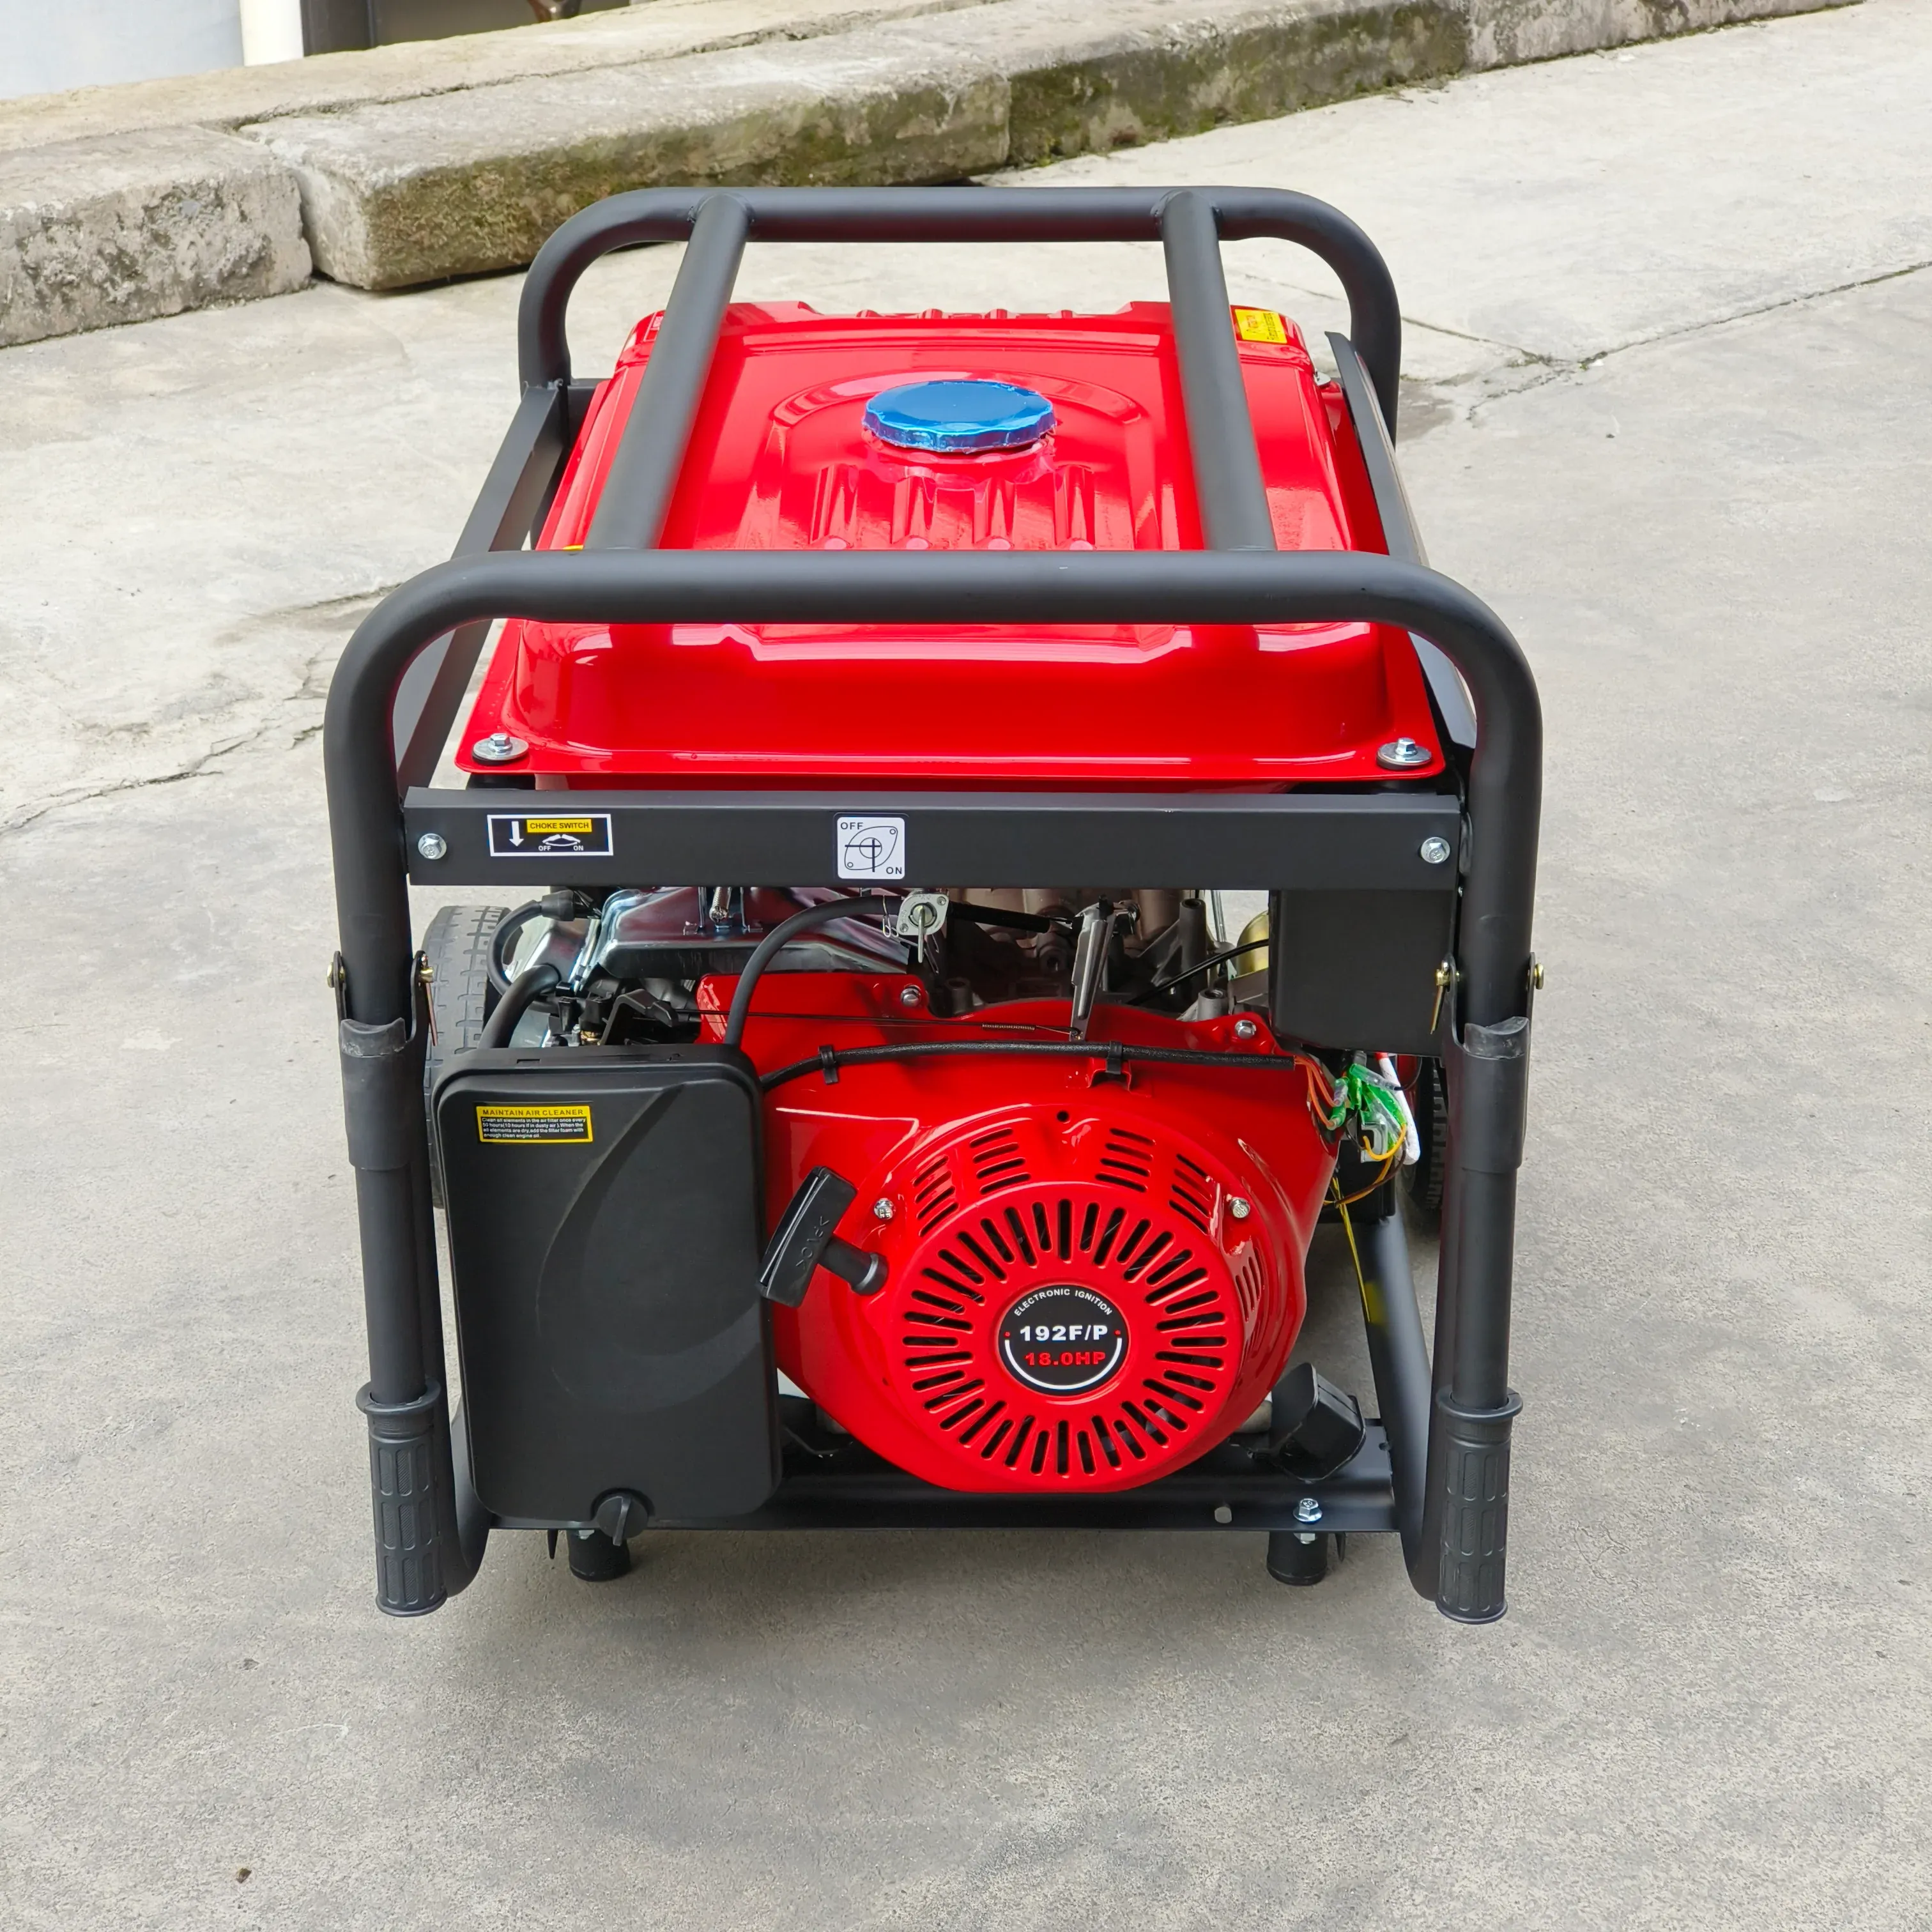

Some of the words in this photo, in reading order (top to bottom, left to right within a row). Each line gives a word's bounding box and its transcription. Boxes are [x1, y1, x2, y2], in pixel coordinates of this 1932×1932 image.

[840, 822, 864, 830] OFF
[885, 866, 902, 875] ON
[1014, 1288, 1070, 1316] ELECTRONIC
[1075, 1290, 1113, 1315] IGNITION
[1020, 1324, 1108, 1342] 192F/P
[1024, 1351, 1106, 1365] 18.0HP
